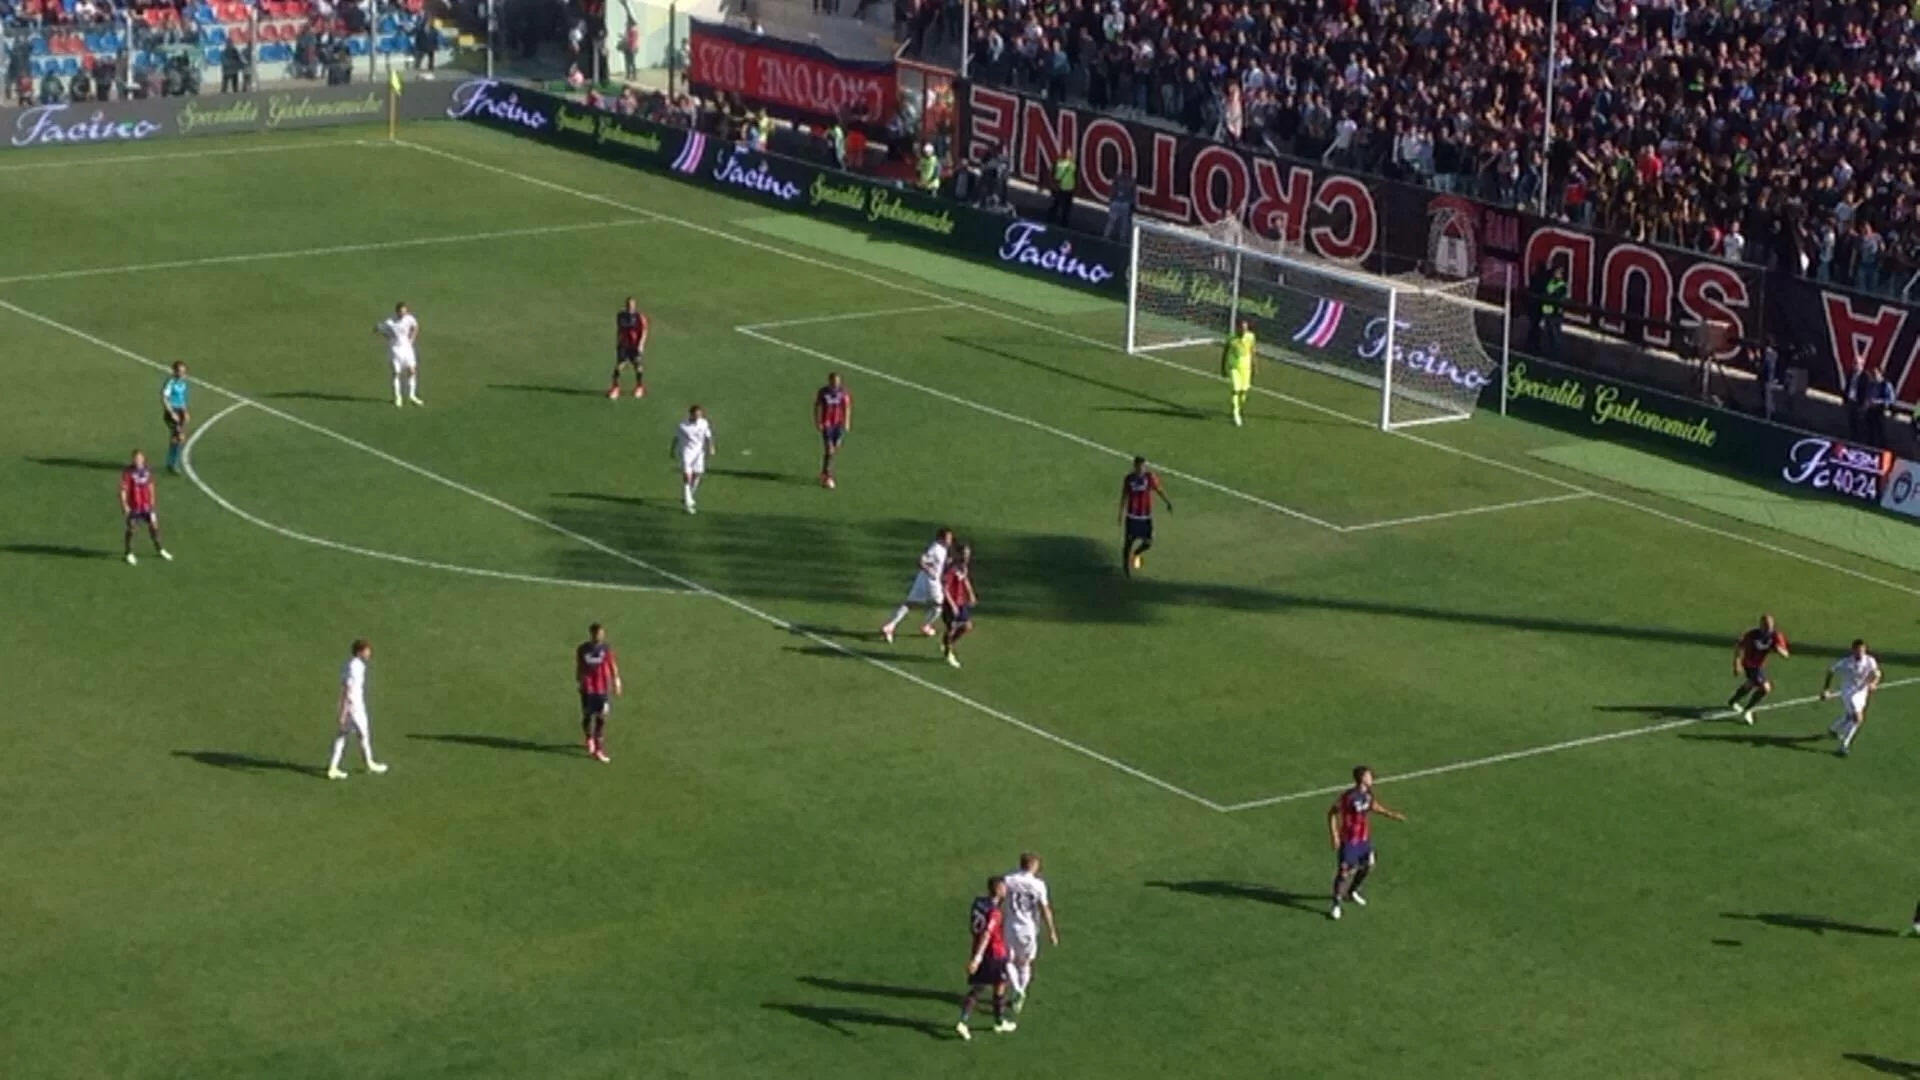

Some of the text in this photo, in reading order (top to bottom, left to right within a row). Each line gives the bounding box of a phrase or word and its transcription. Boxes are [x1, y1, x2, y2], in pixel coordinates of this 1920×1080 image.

[701, 42, 746, 90] 1923
[11, 103, 162, 147] Facino
[969, 85, 1378, 264] CROTONE
[999, 218, 1113, 284] Facino
[1525, 227, 1750, 361] SUD
[1593, 383, 1717, 449] Gastronomiche
